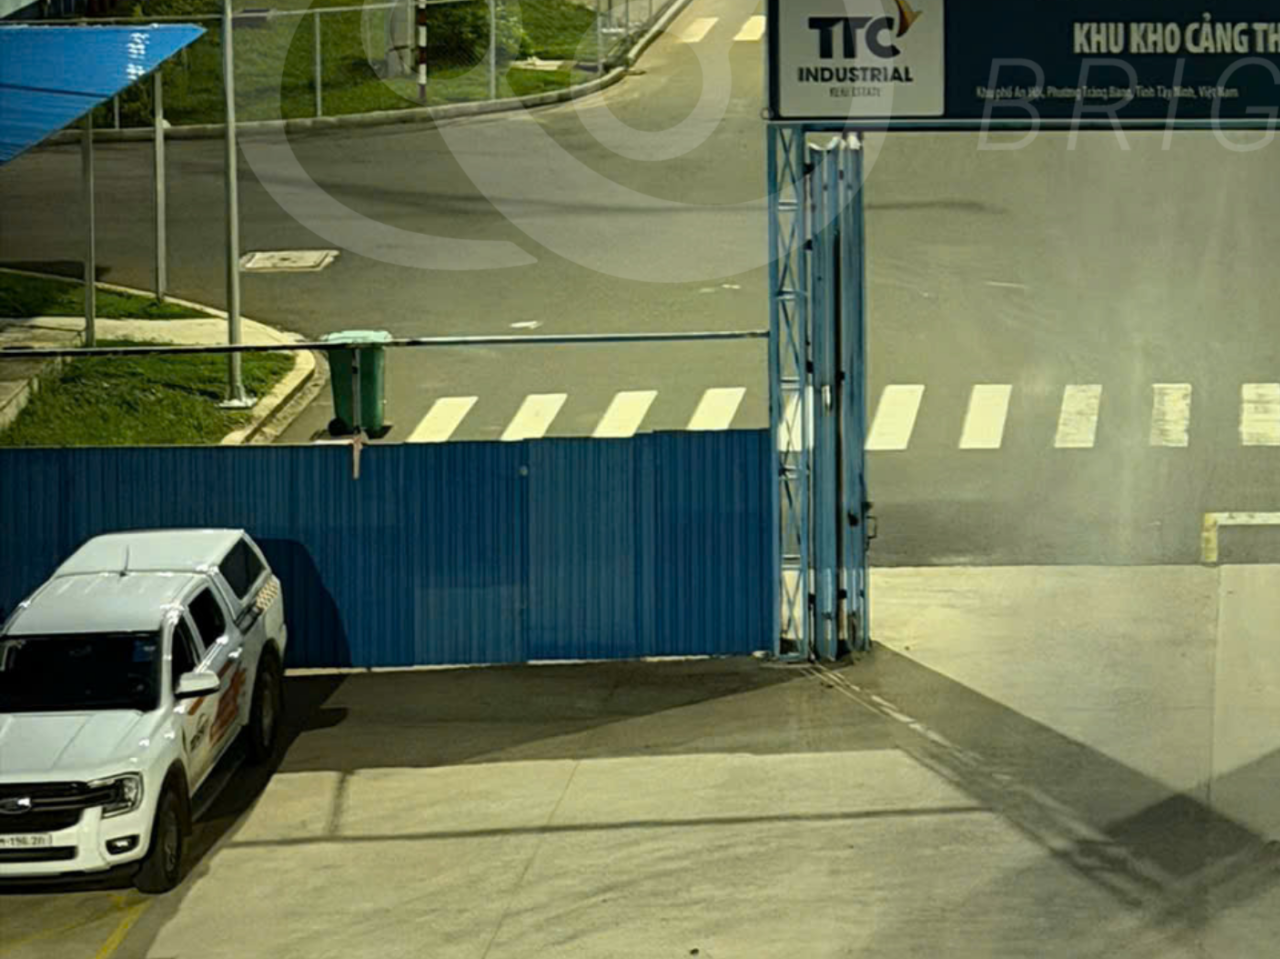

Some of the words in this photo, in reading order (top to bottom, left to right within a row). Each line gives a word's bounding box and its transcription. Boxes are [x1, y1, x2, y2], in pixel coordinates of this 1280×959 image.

[808, 16, 901, 59] TTC
[1073, 21, 1126, 54] KHU
[1128, 21, 1182, 54] KHO
[1185, 11, 1250, 54] CẢNG
[798, 67, 914, 82] INDUSTRIAL
